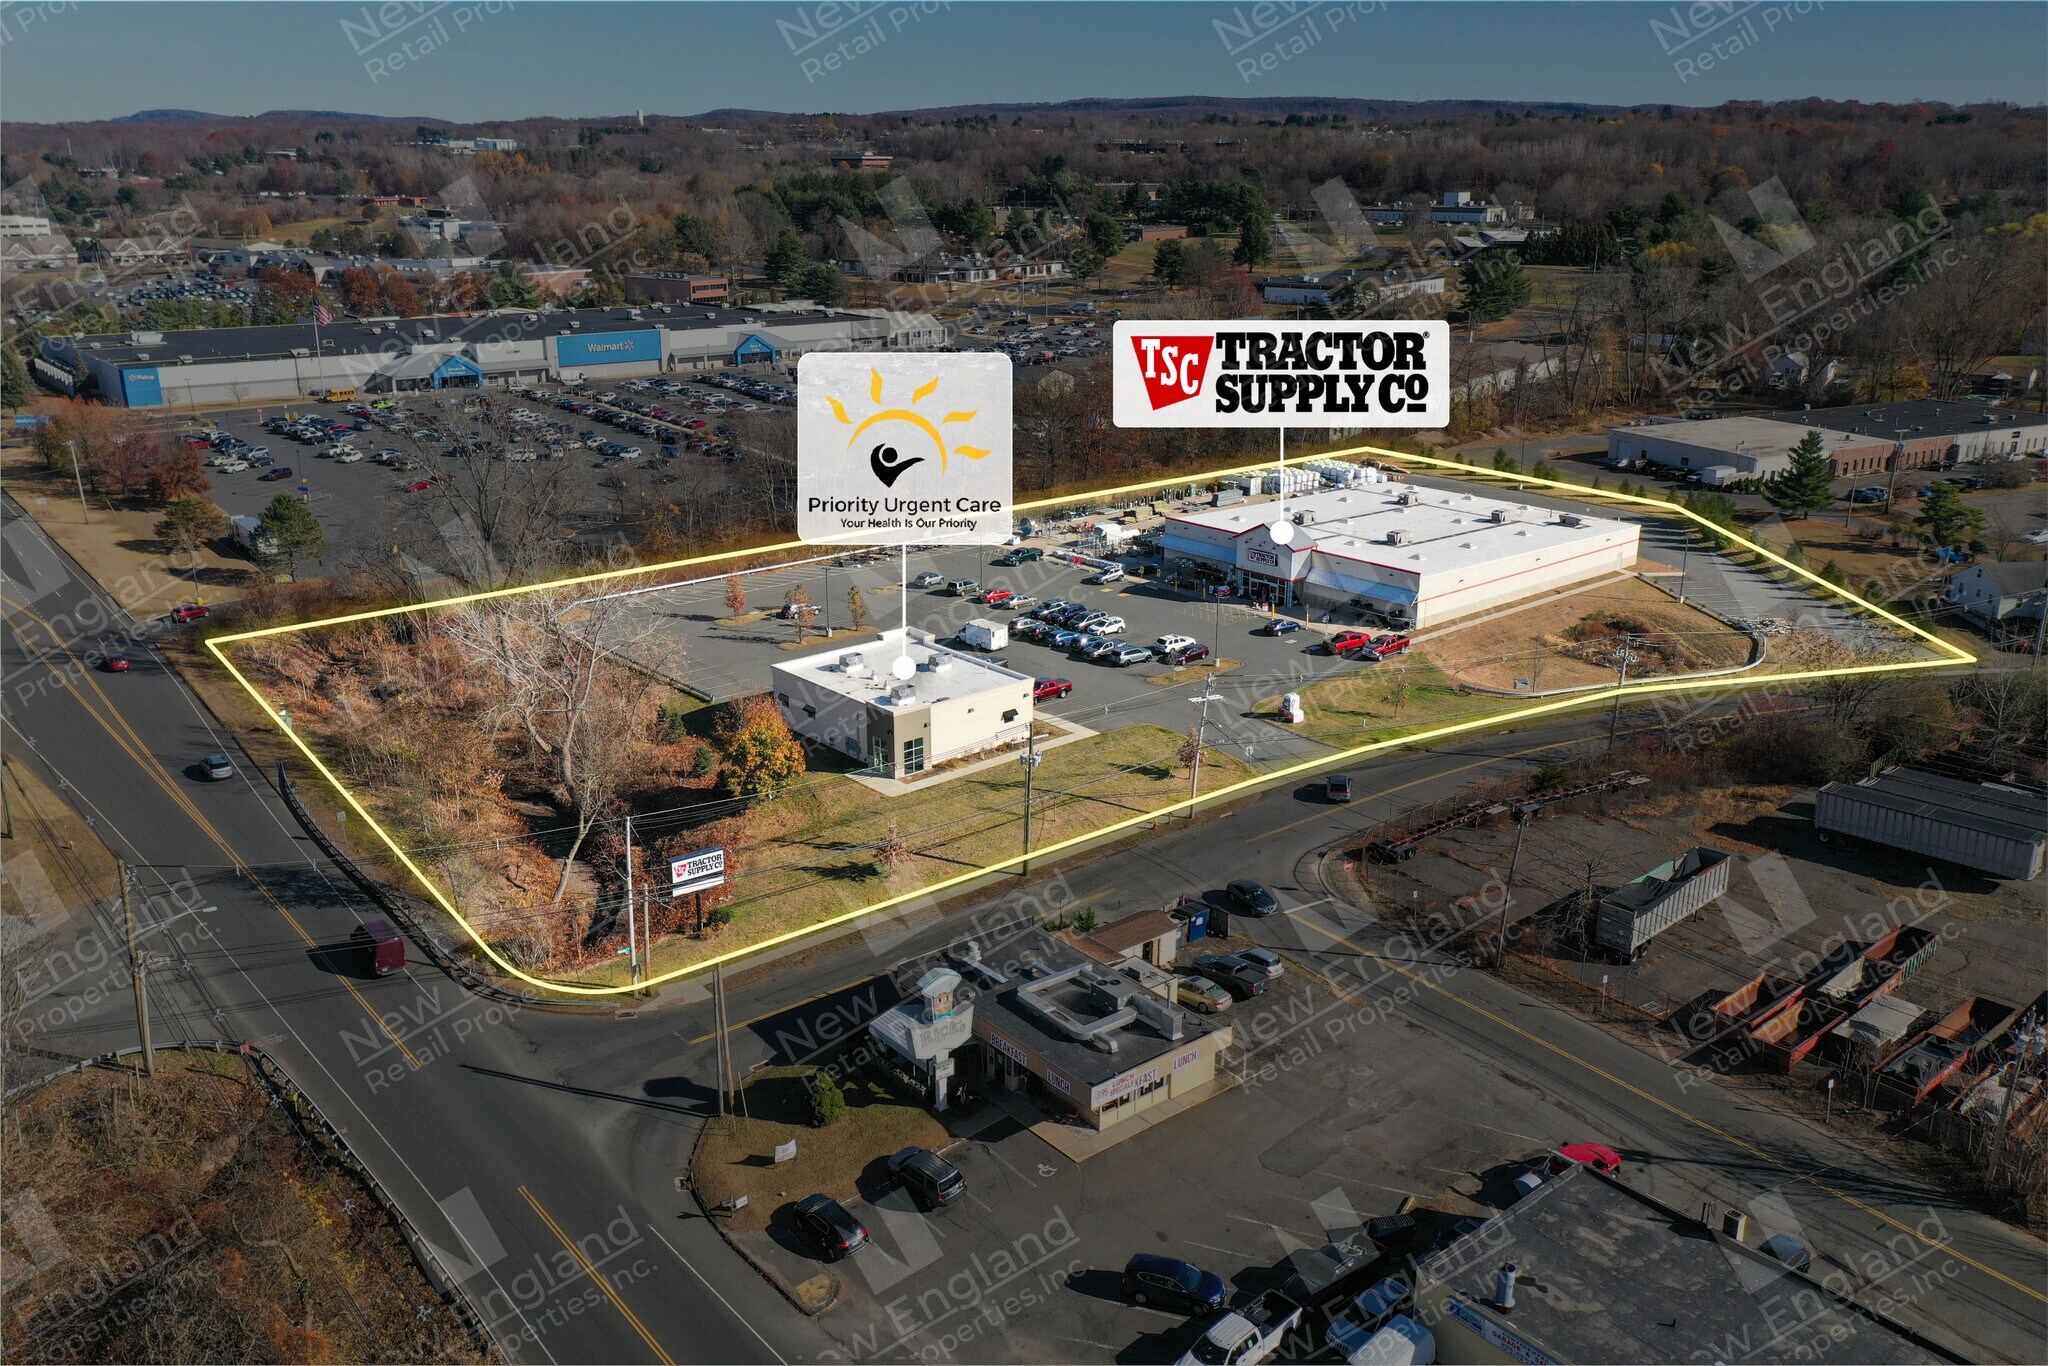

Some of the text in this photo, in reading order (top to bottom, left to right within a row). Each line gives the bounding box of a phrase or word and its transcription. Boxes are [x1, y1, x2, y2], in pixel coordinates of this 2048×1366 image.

[587, 341, 624, 353] Walmart
[687, 854, 722, 868] TRACTOR
[687, 864, 713, 876] SUPPLY
[991, 1033, 1026, 1065] BREAKFAST
[1174, 1050, 1197, 1070] LUNCH
[1049, 1070, 1070, 1094] LUNCH
[1112, 1073, 1135, 1087] LUNCH
[1491, 1330, 1521, 1351] GARAGE
